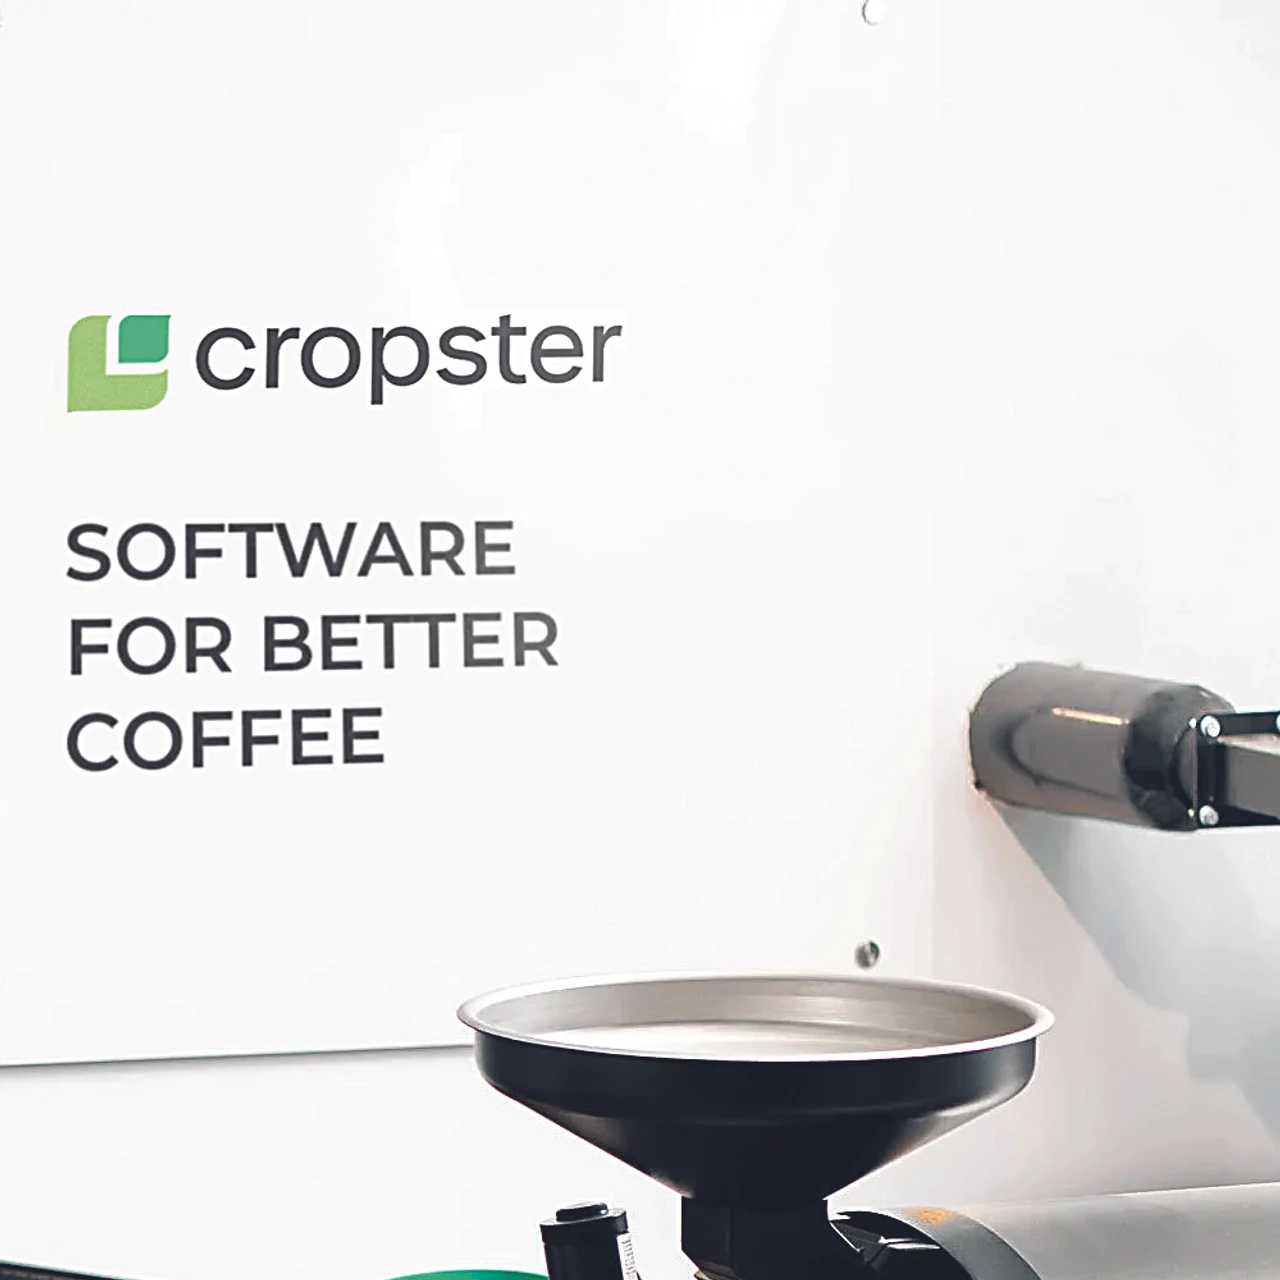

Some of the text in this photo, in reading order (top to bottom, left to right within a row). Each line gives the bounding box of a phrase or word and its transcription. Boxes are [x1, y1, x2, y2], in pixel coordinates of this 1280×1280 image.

[196, 314, 622, 405] cropster
[67, 521, 515, 581] SOFTWARE
[71, 612, 558, 675] FOR BETTER
[67, 707, 384, 771] COFFEE
